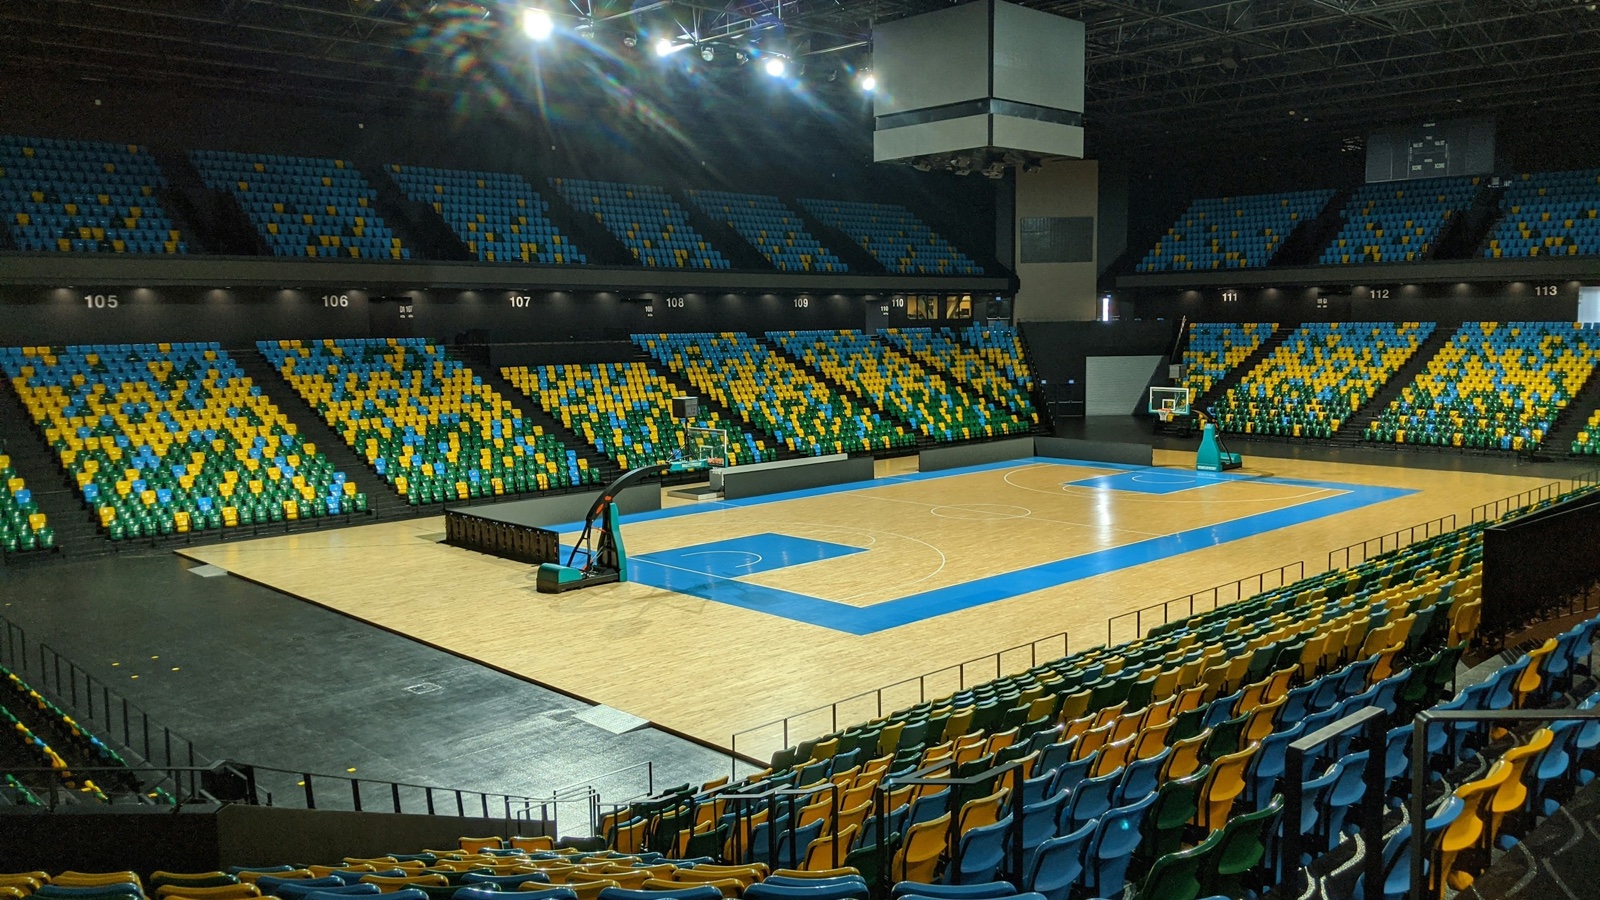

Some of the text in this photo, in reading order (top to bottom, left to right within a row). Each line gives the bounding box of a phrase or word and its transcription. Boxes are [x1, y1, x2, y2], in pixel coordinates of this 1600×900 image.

[1370, 289, 1389, 299] 112
[1535, 286, 1557, 296] 113
[84, 294, 118, 308] 105
[322, 295, 348, 307] 106
[509, 296, 531, 307] 107
[666, 298, 684, 307] 108
[892, 298, 904, 307] 110
[1222, 293, 1238, 302] 111
[793, 298, 809, 308] 109
